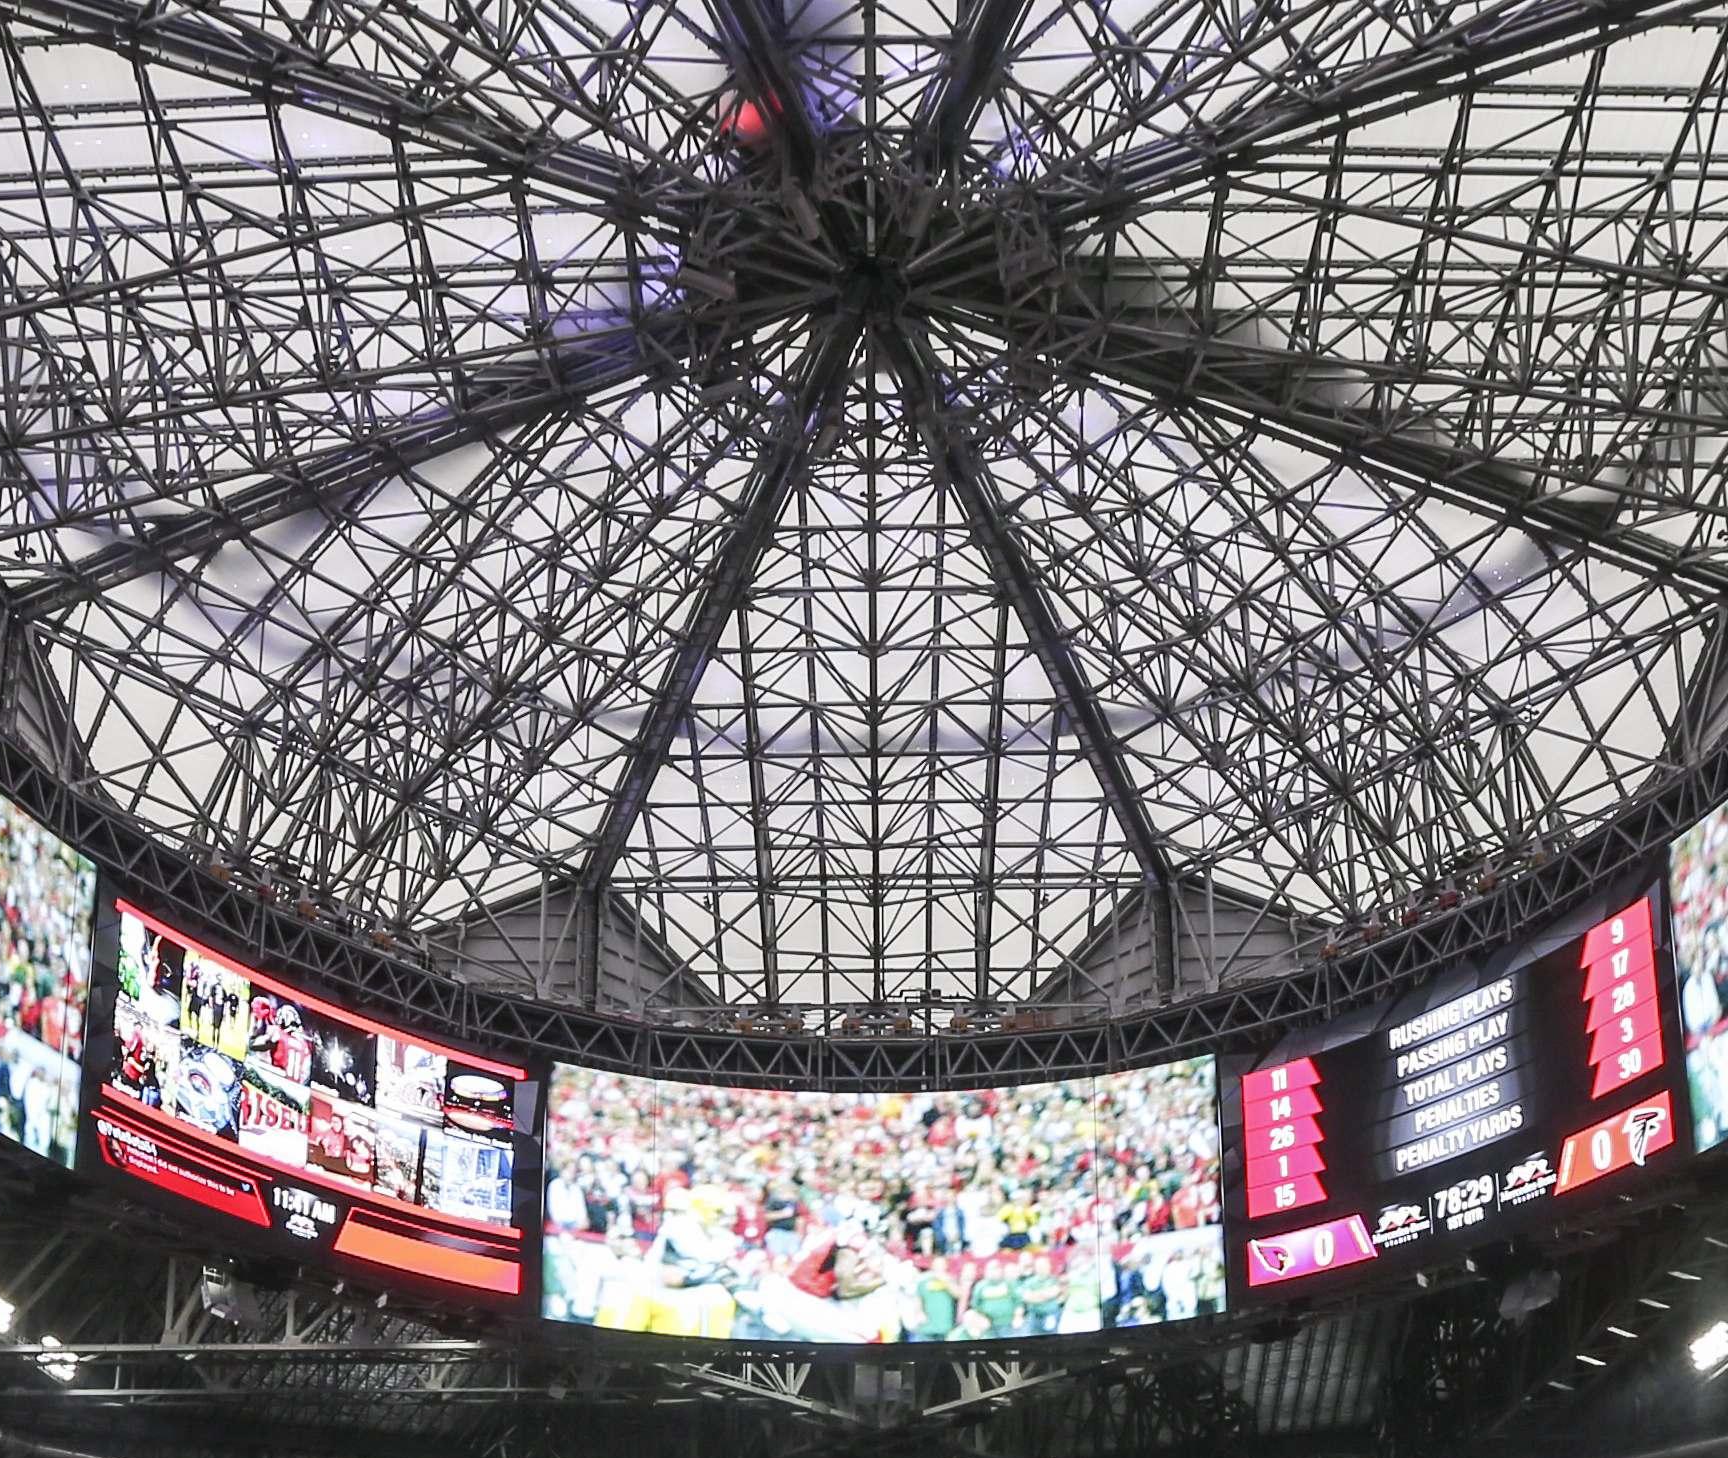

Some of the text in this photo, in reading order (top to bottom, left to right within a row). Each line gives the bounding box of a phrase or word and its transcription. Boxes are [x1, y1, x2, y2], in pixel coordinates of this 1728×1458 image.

[1611, 919, 1624, 944] 9
[1612, 949, 1629, 977] 17
[1613, 981, 1635, 1013] 28
[1389, 978, 1513, 1050] RUSHING PLAYS
[1396, 1012, 1509, 1078] PASSING PLAY
[1620, 1018, 1634, 1042] 3
[1403, 1046, 1508, 1105] TOTAL PLAYS
[1619, 1048, 1642, 1079] 30
[1271, 1070, 1287, 1091] 11
[1271, 1099, 1291, 1120] 14
[1415, 1082, 1501, 1133] PENALTIES
[1271, 1127, 1295, 1150] 26
[1396, 1105, 1523, 1171] PENALTY YARDS
[1591, 1132, 1612, 1170] 0
[1279, 1157, 1288, 1177] 1
[273, 1187, 337, 1224] 11:41 AM
[1274, 1186, 1296, 1206] 15
[1433, 1174, 1494, 1219] 78:29
[1446, 1207, 1485, 1230] 1ST QTR
[1313, 1230, 1334, 1266] 0
